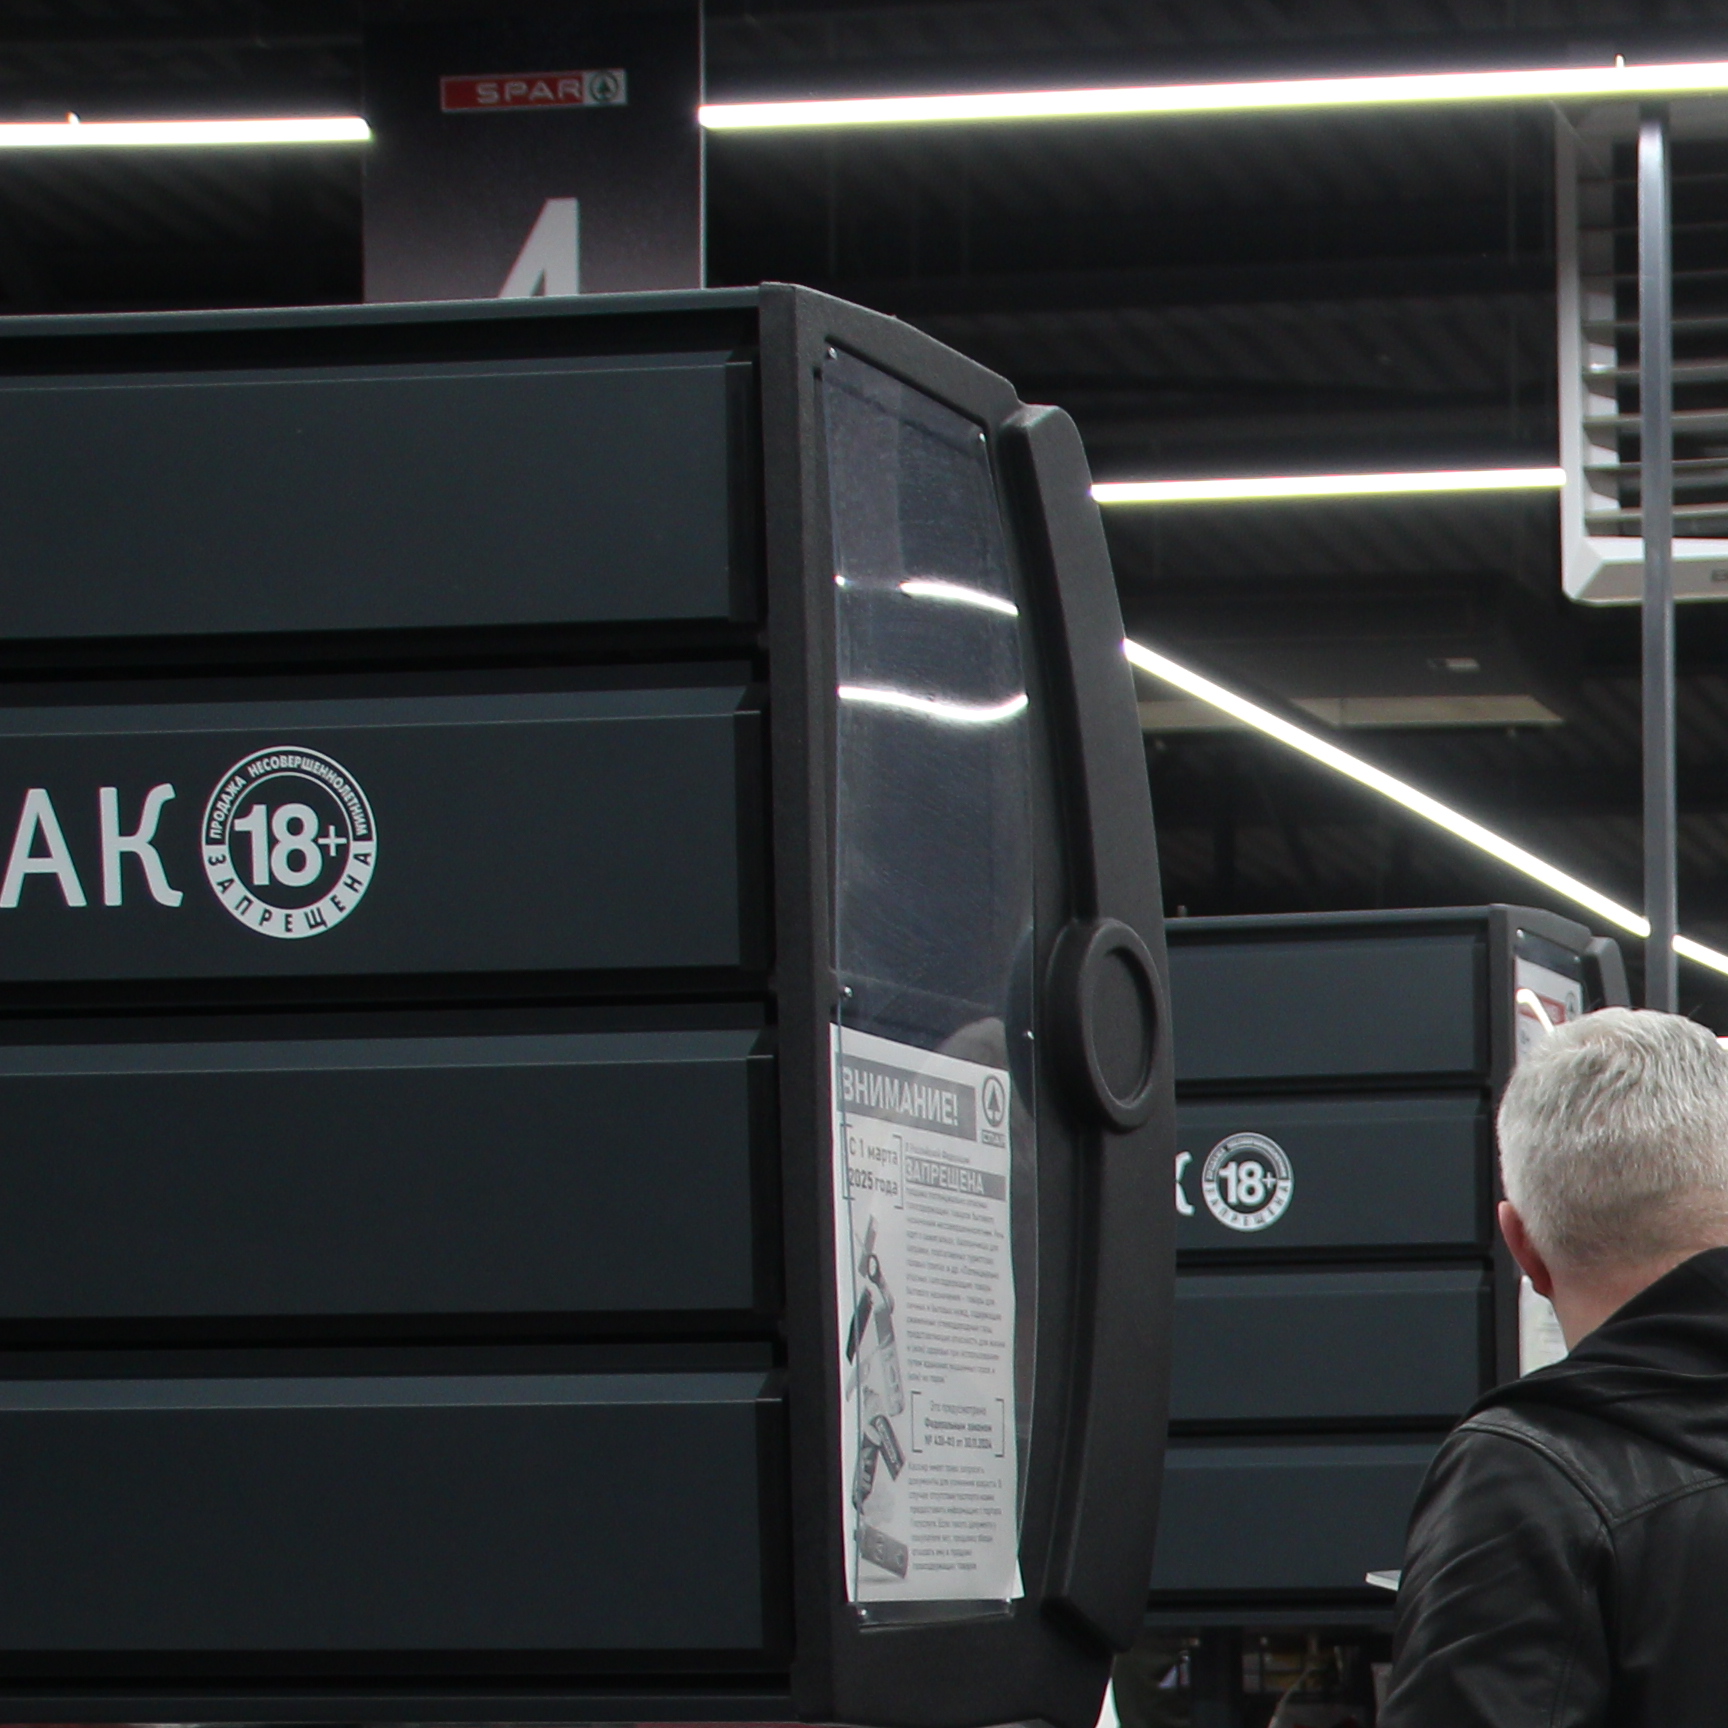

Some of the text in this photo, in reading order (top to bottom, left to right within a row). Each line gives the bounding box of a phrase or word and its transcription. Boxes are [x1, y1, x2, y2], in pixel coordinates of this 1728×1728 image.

[477, 78, 581, 104] SPAR
[207, 776, 247, 840] ПРОДАЖА
[234, 802, 348, 888] 18+
[207, 849, 373, 934] ЗАПРЕЩЕНА
[842, 1066, 959, 1127] ВНИМАНИЕ!
[867, 1147, 898, 1168] марта
[905, 1158, 985, 1195] ЗАПРЕЩЕНА
[1218, 1160, 1277, 1207] 18+
